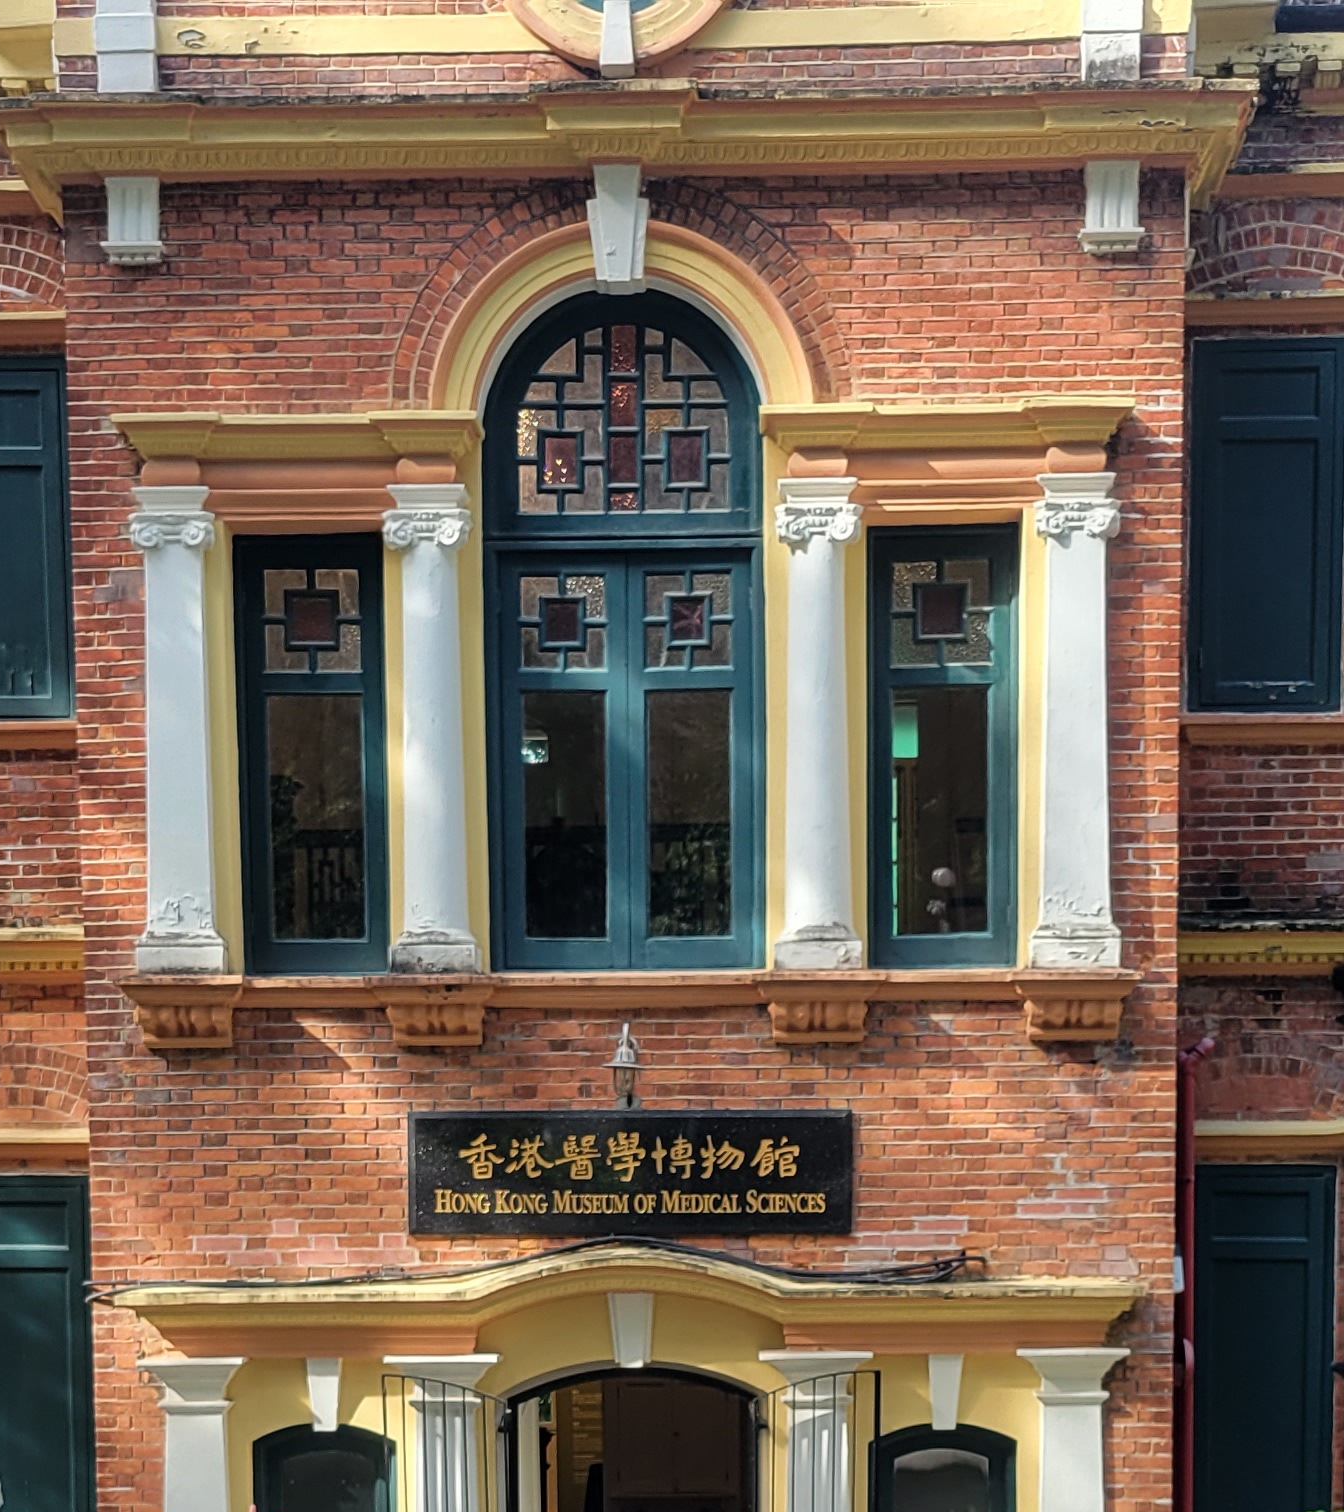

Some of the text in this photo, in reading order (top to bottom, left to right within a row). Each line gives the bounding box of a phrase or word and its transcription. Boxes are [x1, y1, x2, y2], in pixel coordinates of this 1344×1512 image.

[458, 1131, 802, 1183] 香港醫學博物館
[434, 1188, 827, 1215] HONG KONG MUSEUM OF MEDICAL SCIENCES
